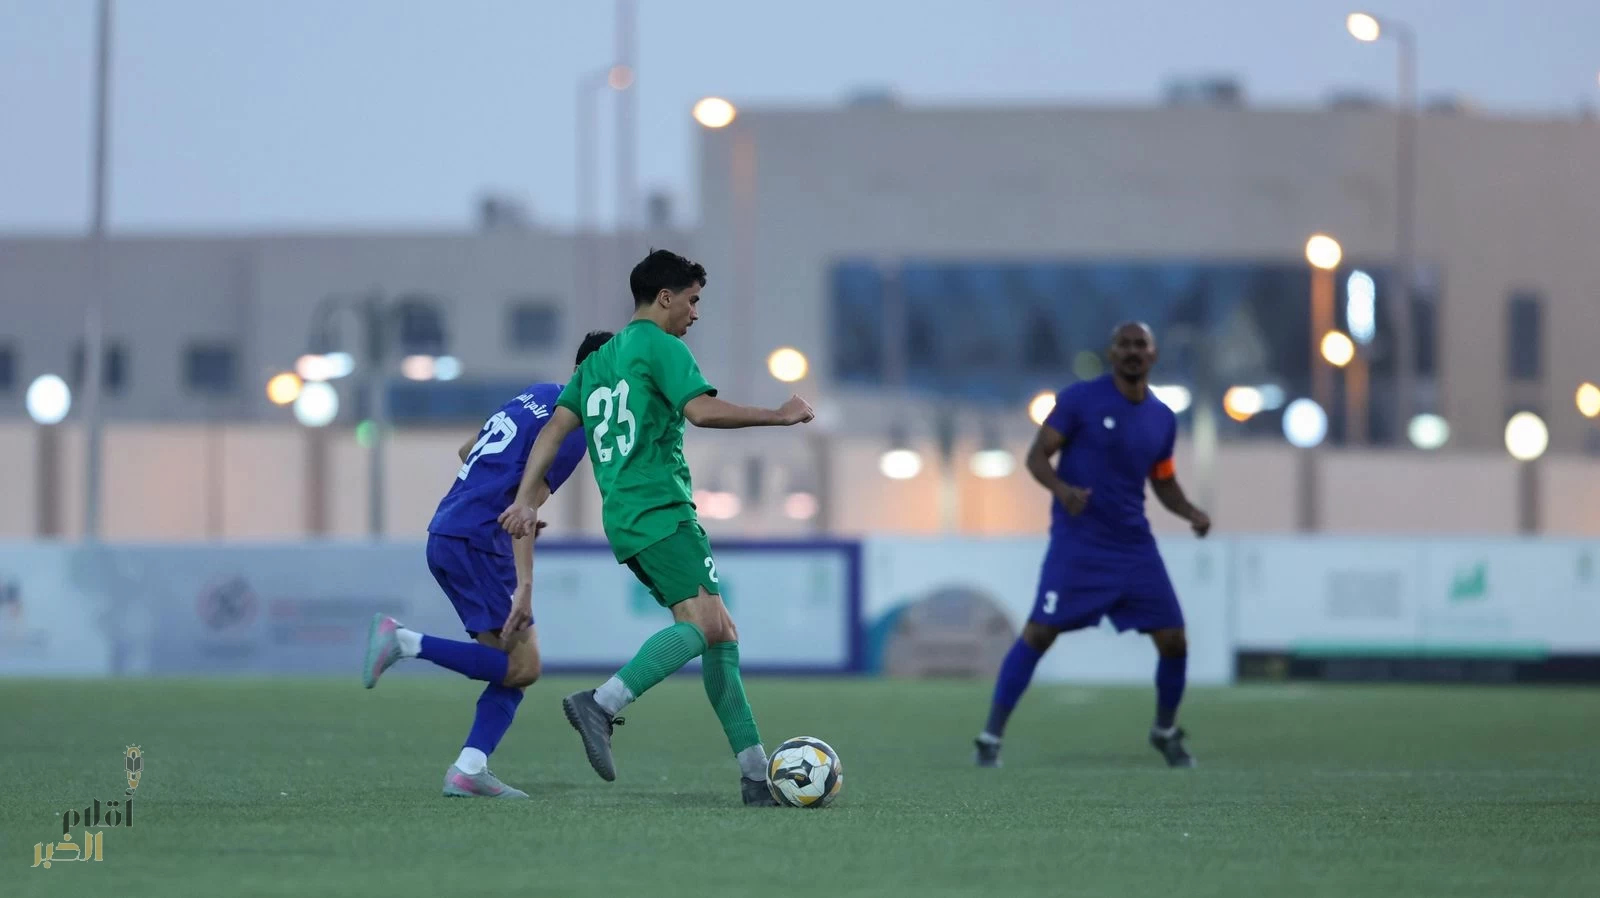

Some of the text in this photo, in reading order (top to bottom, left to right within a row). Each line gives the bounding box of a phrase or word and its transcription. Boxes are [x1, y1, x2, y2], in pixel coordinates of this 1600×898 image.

[523, 400, 549, 419] الأمن
[587, 379, 636, 462] 23
[1043, 590, 1059, 614] 3
